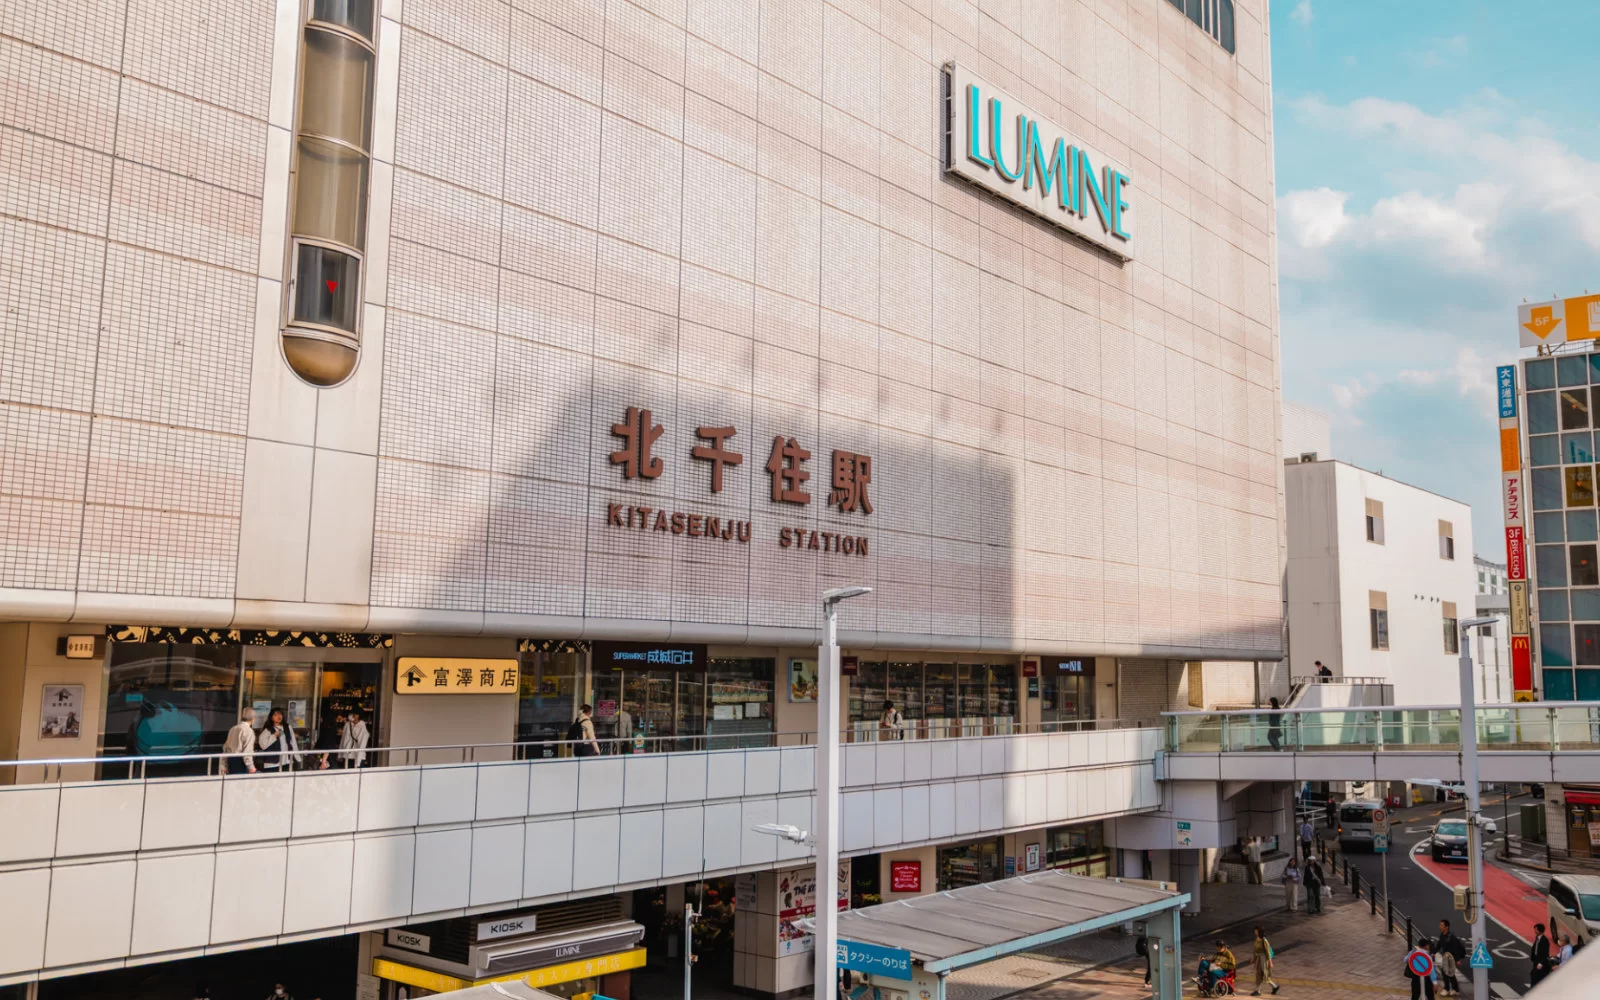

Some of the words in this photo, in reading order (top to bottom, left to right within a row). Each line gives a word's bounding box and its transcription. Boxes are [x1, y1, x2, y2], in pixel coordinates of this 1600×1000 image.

[966, 83, 1131, 241] LUMINE
[1535, 316, 1550, 327] 5F
[609, 407, 874, 514] 北千住駅
[608, 502, 753, 543] KITASENJU
[780, 526, 870, 556] STATION
[1508, 528, 1521, 539] 3F
[1510, 539, 1519, 555] BIG
[1512, 556, 1521, 578] ECHO
[433, 667, 517, 687] 富澤商店
[491, 921, 524, 934] KIOSK
[397, 933, 421, 947] KIOSK
[555, 944, 582, 958] LUMINE
[850, 951, 907, 970] タクシーのりば
